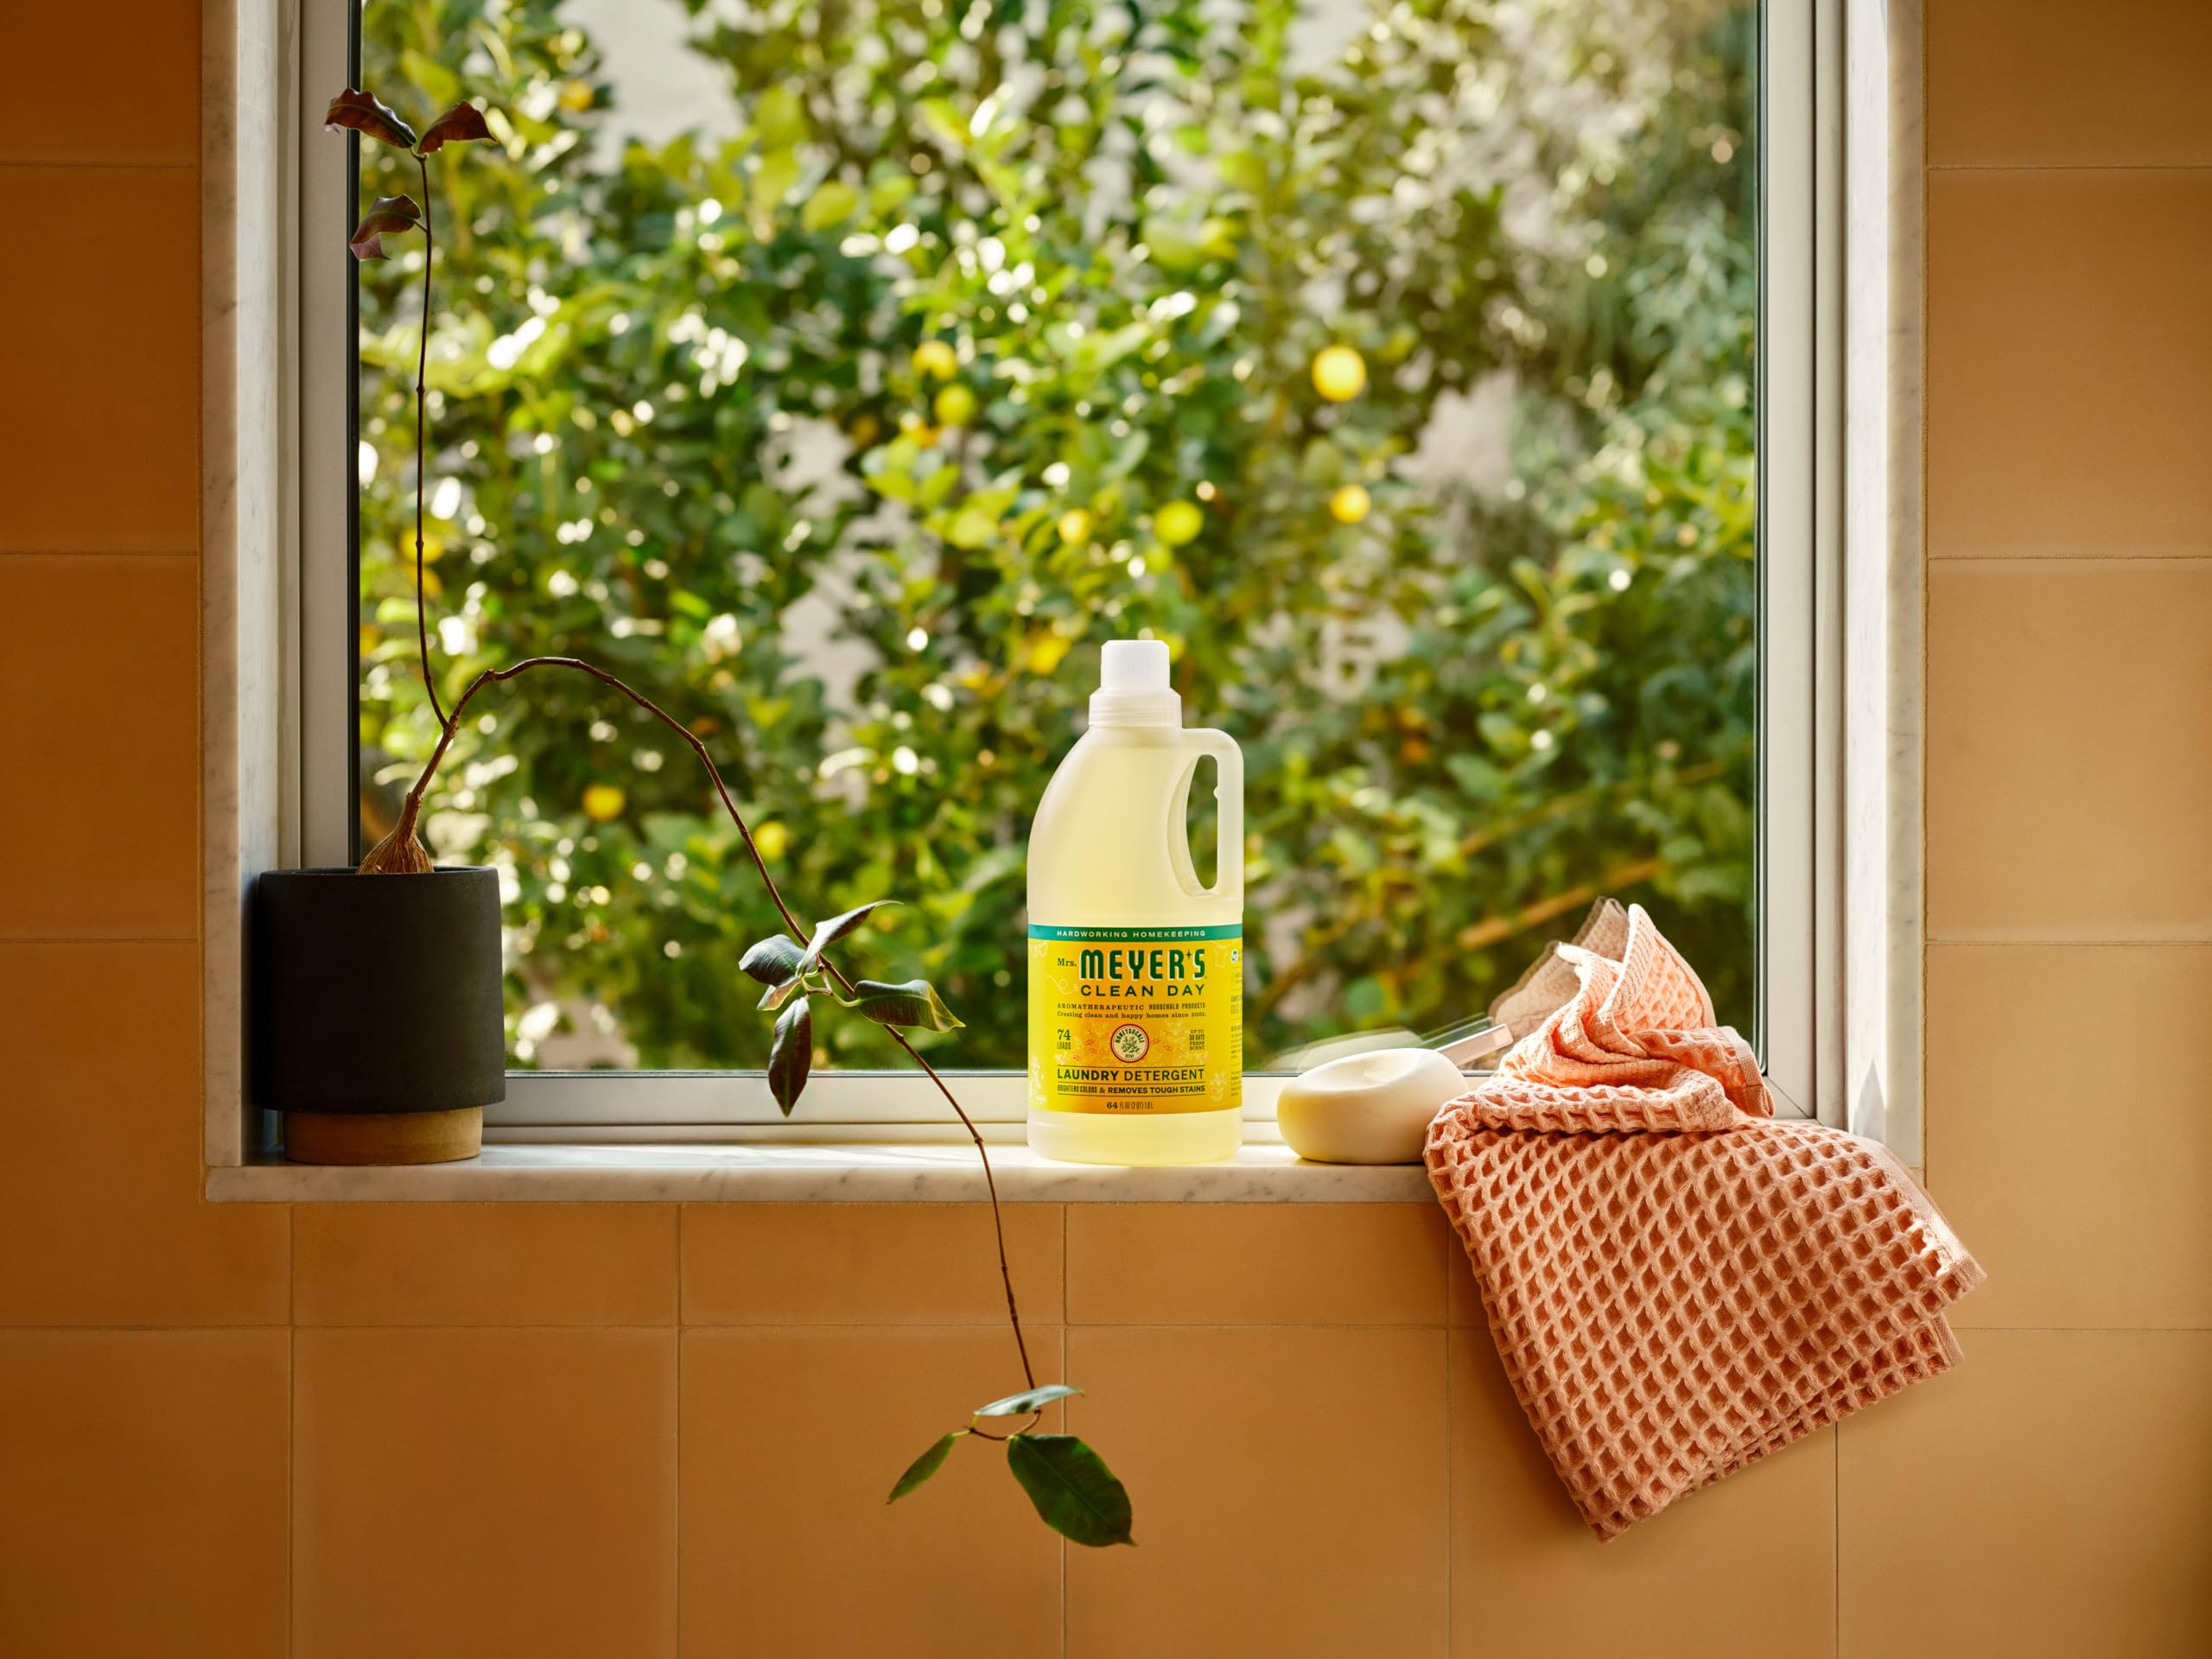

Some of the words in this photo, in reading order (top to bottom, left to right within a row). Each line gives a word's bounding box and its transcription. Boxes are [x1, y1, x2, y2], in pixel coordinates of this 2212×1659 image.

[1057, 957, 1077, 967] Mrs.
[1079, 949, 1205, 981] MEYER'S
[1080, 984, 1154, 997] CLEAN
[1167, 983, 1205, 996] DAY
[1057, 1002, 1145, 1011] AROMATHERAPEUTIC
[1057, 1010, 1083, 1019] Creating
[1057, 1029, 1071, 1040] 74
[1115, 1028, 1145, 1043] HONEYSUCKLE
[1057, 1041, 1071, 1050] LOADS
[1057, 1068, 1119, 1081] LAUNDRY
[1124, 1069, 1205, 1081] DETERGENT
[1107, 1101, 1118, 1109] 64
